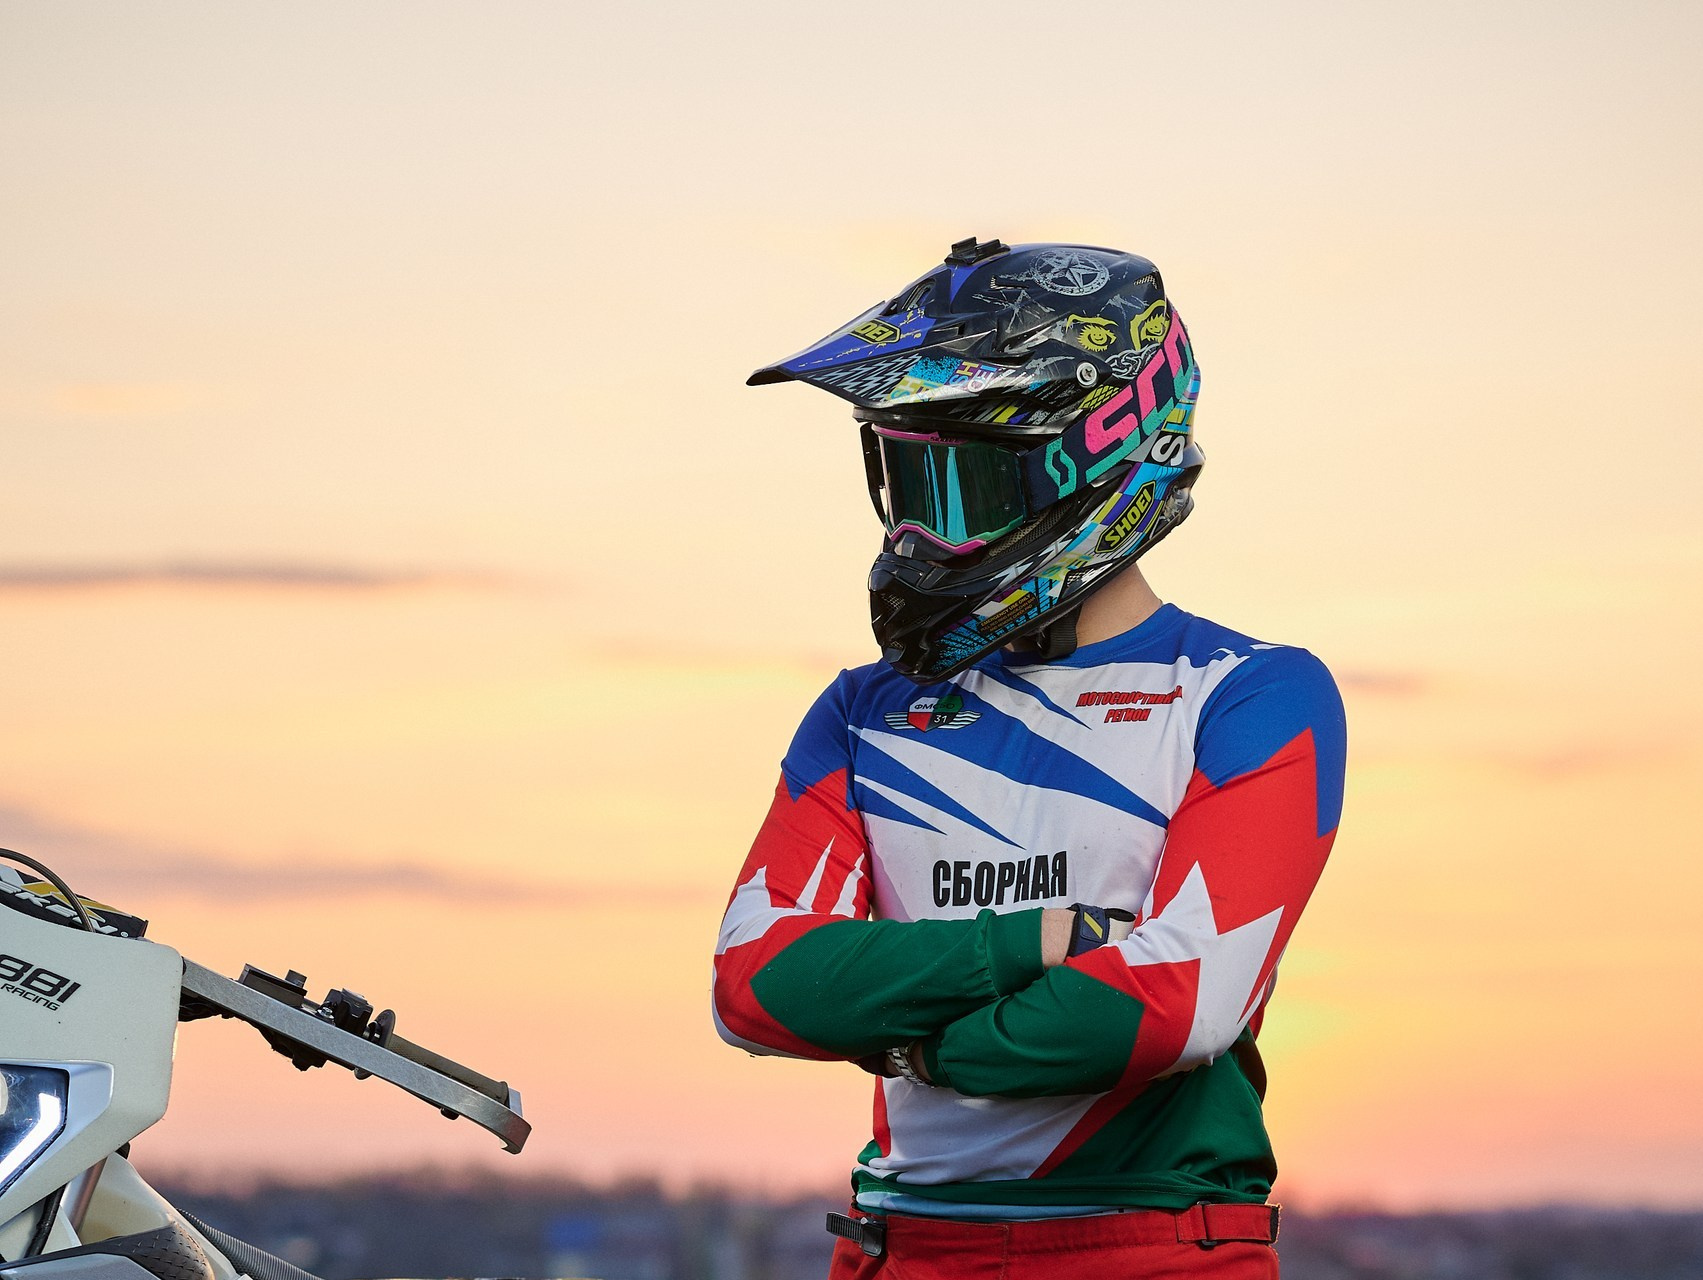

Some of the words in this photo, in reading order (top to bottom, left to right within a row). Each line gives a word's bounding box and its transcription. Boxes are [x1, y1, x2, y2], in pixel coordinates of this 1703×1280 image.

[1105, 489, 1152, 547] SHOEI
[981, 608, 1008, 626] EMERGENCY
[1008, 602, 1018, 610] USE
[1018, 594, 1031, 604] ONLY
[934, 714, 947, 723] 31
[1104, 708, 1152, 723] РЕГИОН
[933, 851, 1067, 908] СБОРНАЯ
[1, 983, 60, 1011] RACING
